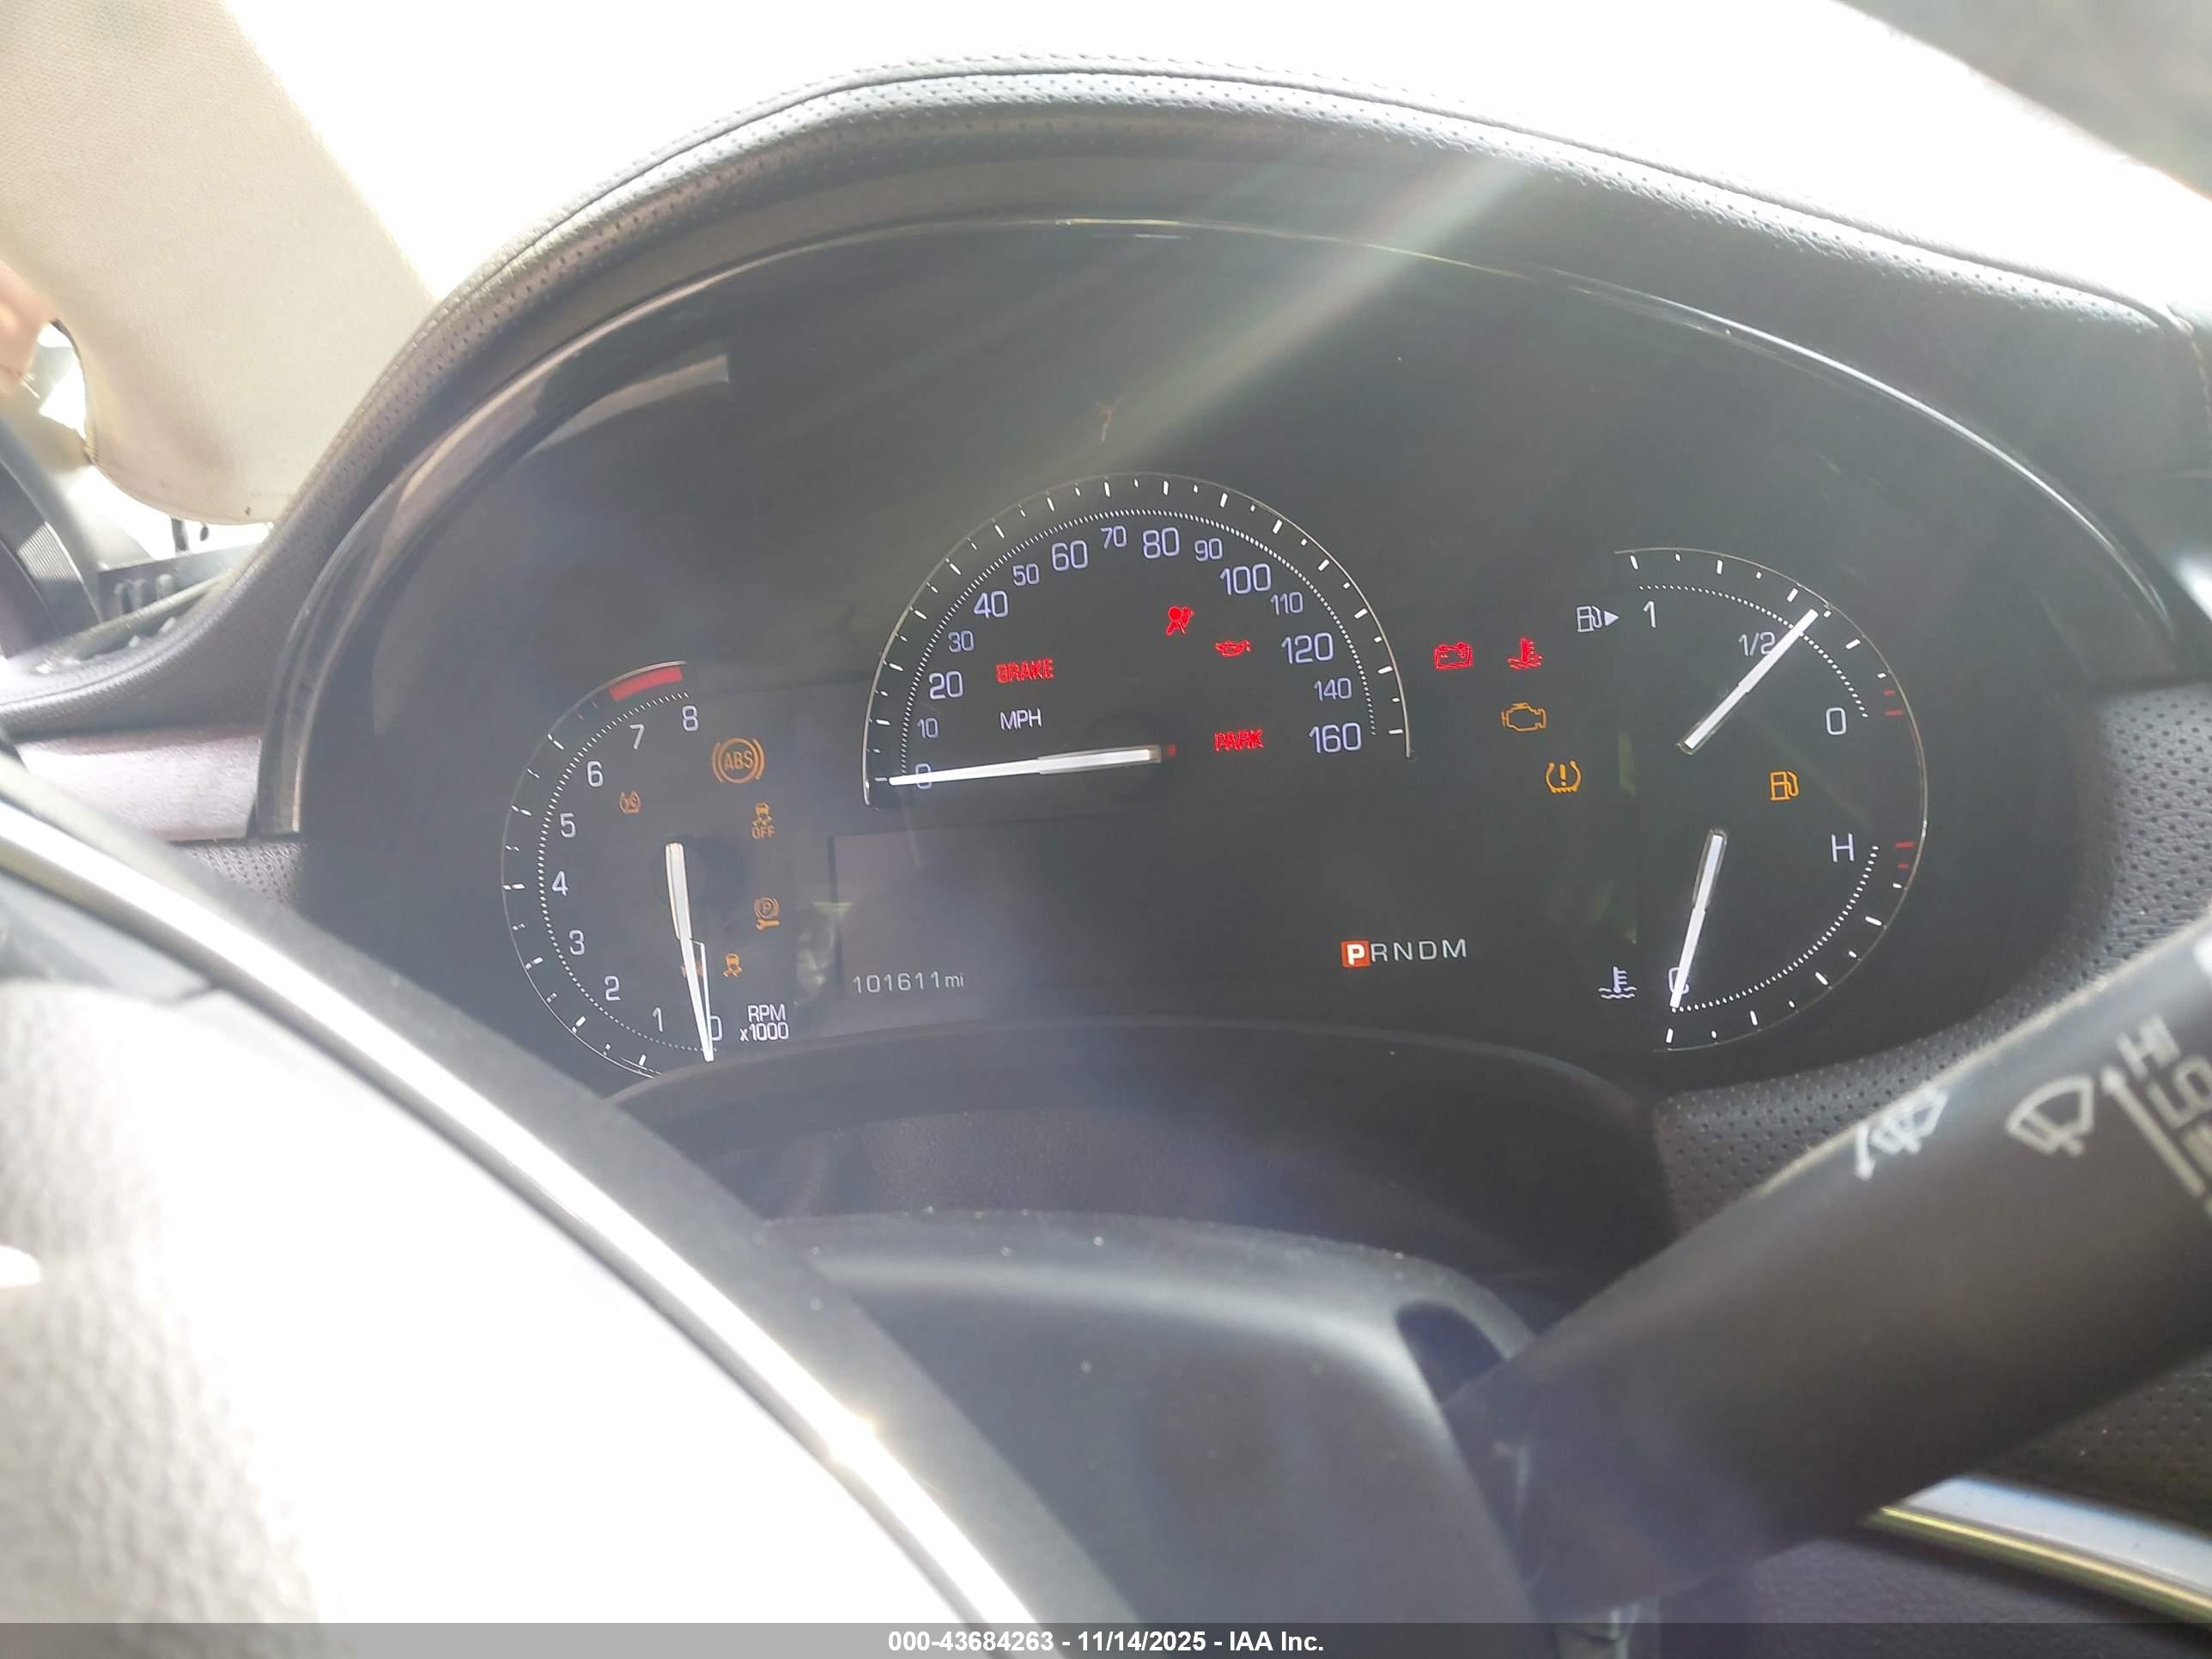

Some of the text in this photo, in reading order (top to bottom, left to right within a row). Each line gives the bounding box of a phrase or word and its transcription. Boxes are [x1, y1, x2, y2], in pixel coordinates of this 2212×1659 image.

[1101, 526, 1127, 548] 70
[1143, 527, 1179, 558] 80
[1052, 540, 1087, 570] 60
[1195, 538, 1222, 561] 90
[1013, 563, 1039, 586] 50
[1220, 563, 1272, 594] 100
[974, 591, 1008, 618] 40
[1271, 592, 1303, 615] 110
[1644, 601, 1656, 628] 1
[949, 631, 974, 652] 30
[1282, 633, 1333, 664] 120
[995, 658, 1054, 684] BRAKE
[929, 672, 963, 699] 20
[1315, 678, 1352, 701] 140
[683, 706, 698, 731] 8
[918, 718, 938, 738] 10
[1000, 708, 1042, 730] MPH
[629, 724, 645, 749] 7
[1213, 728, 1264, 752] PARK
[1310, 723, 1361, 753] 160
[725, 752, 753, 770] ABS
[587, 762, 603, 787] 6
[561, 813, 575, 837] 5
[1832, 834, 1854, 862] H
[552, 872, 568, 896] 4
[569, 930, 584, 955] 3
[605, 976, 620, 1000] 2
[653, 1008, 663, 1031] 1
[748, 1004, 786, 1022] RPM
[740, 1020, 788, 1042] x1000
